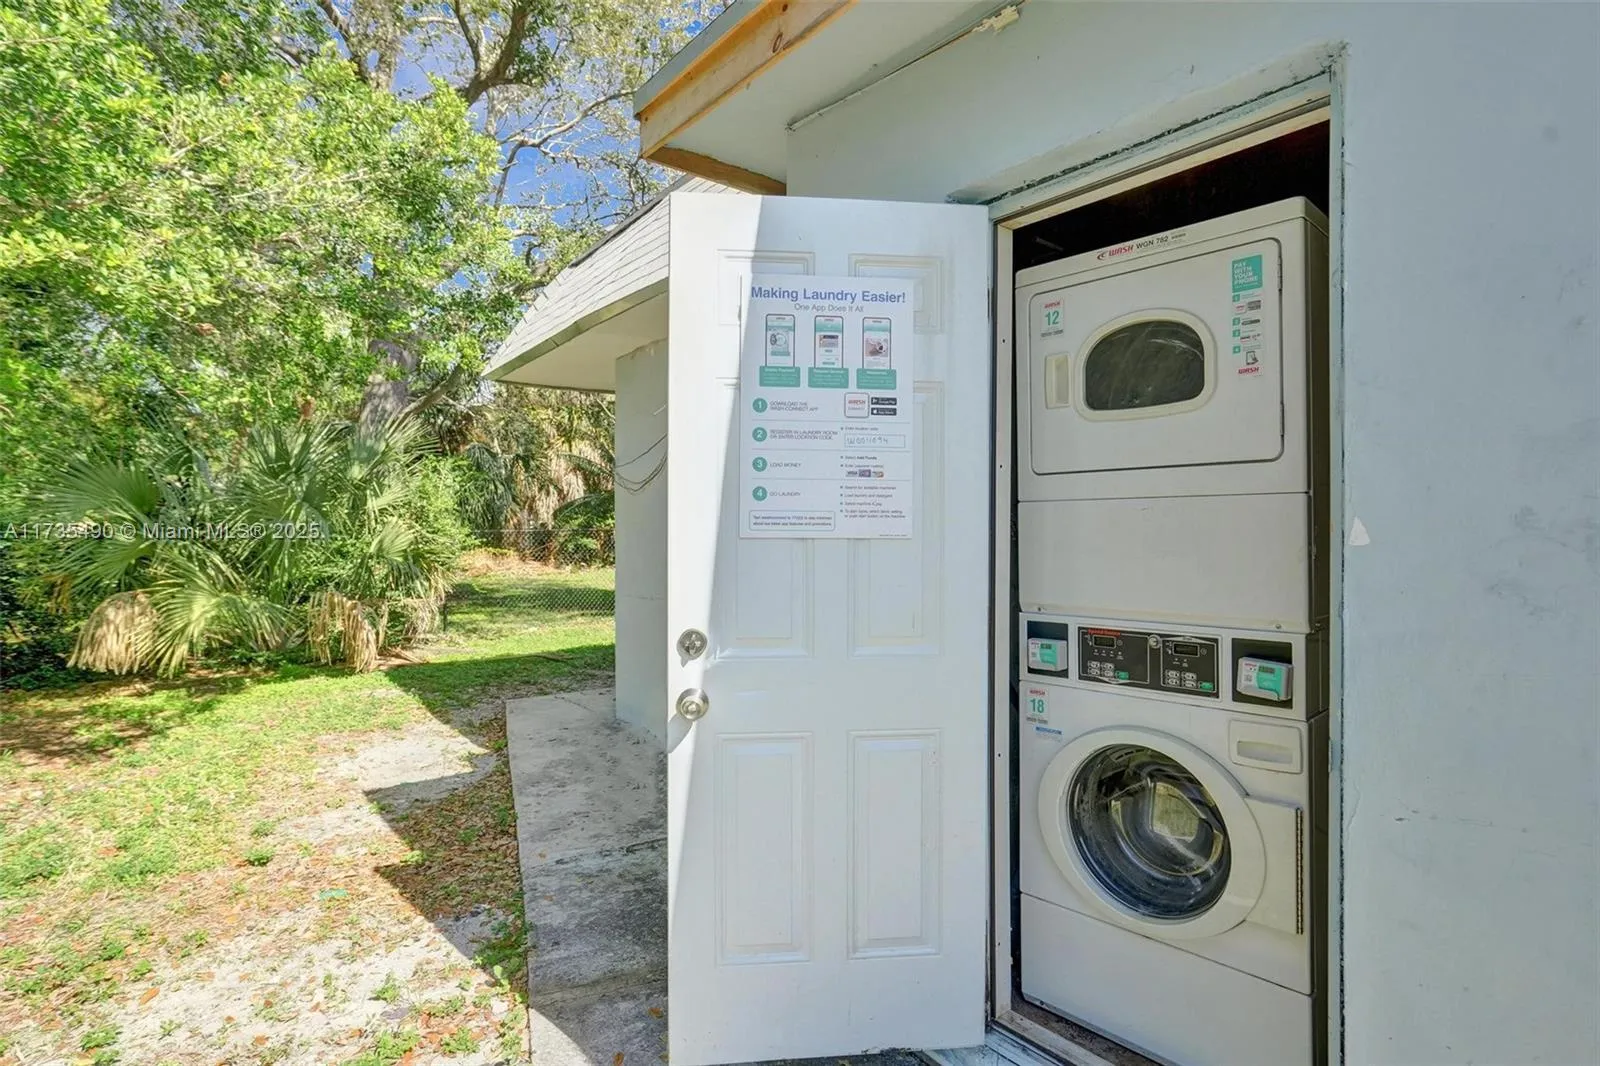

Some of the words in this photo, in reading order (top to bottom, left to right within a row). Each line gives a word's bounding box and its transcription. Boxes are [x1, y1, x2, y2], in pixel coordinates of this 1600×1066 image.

[1109, 244, 1134, 257] WASH
[1136, 240, 1154, 250] WGN
[751, 286, 799, 302] Making
[803, 288, 857, 304] Laundry
[862, 291, 906, 304] Easier!
[794, 304, 810, 312] One
[812, 304, 826, 313] App
[1045, 310, 1060, 326] 12
[757, 430, 763, 439] 2
[757, 459, 763, 468] 3
[756, 488, 763, 497] 4
[1030, 698, 1045, 714] 18
